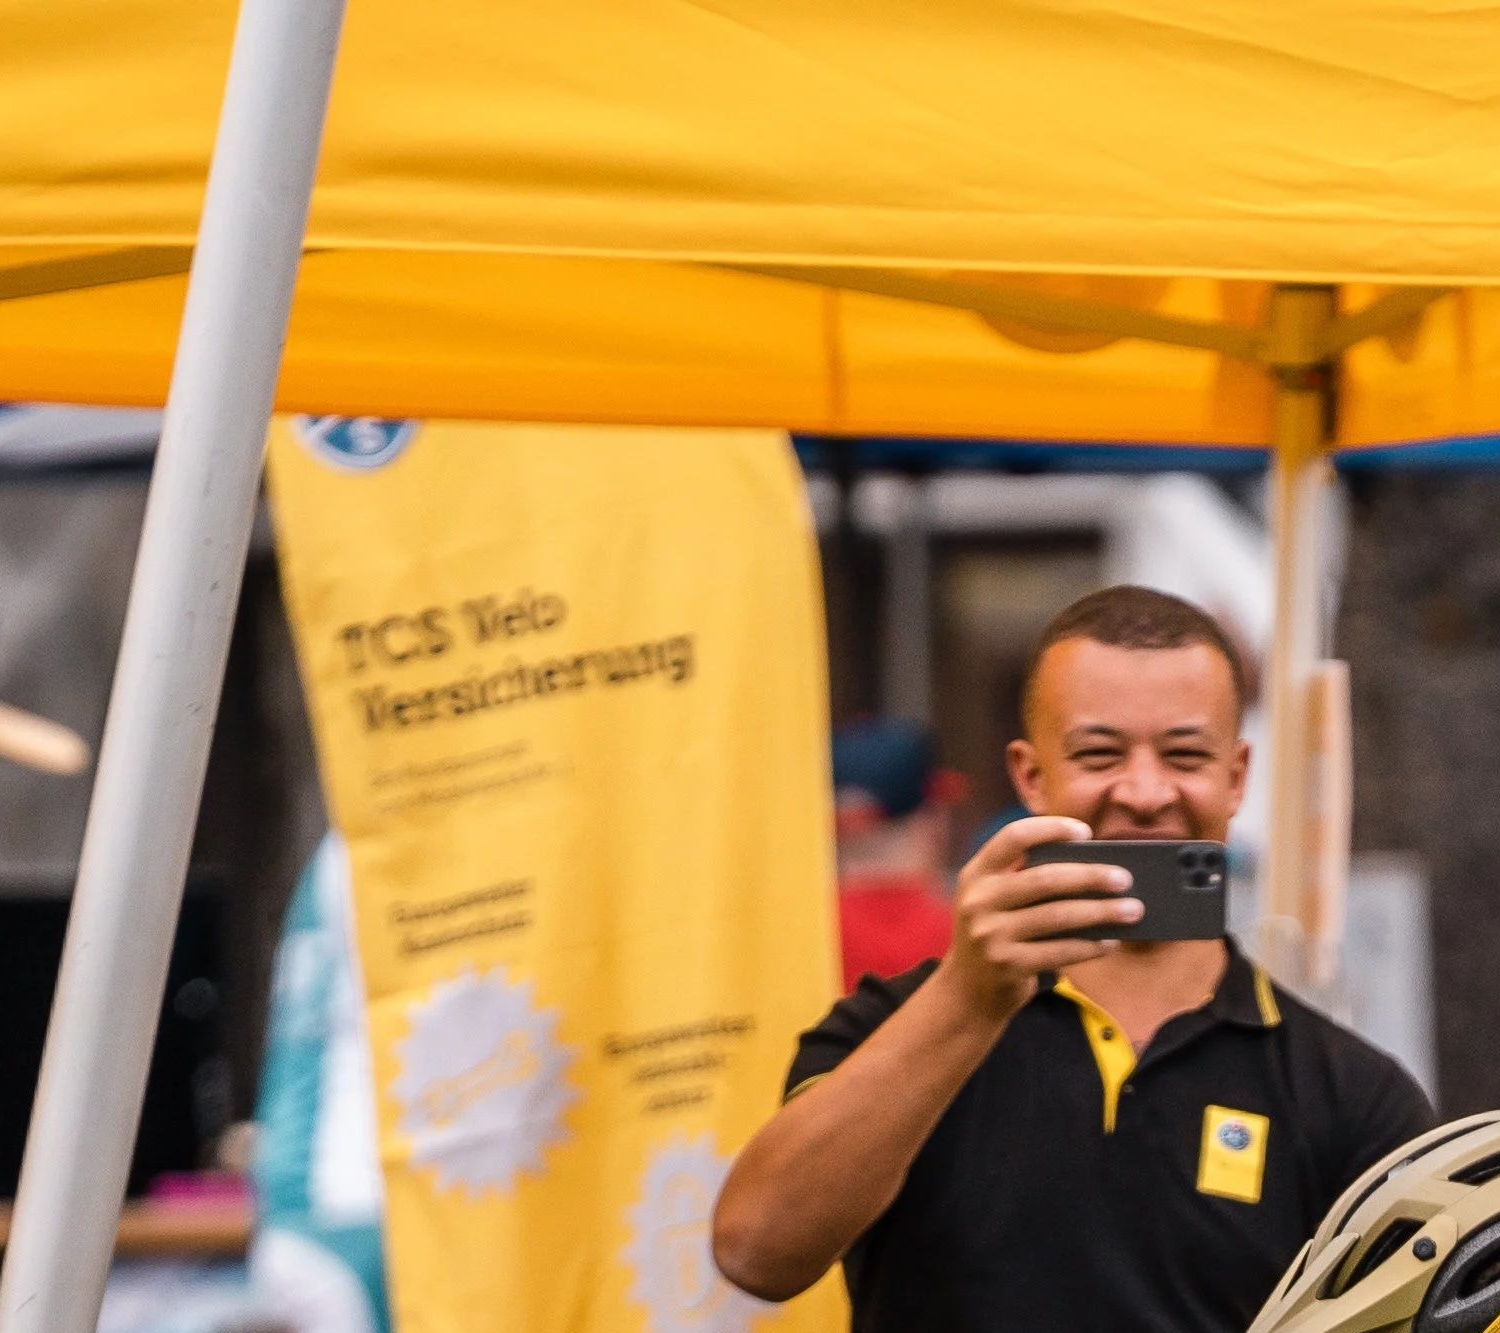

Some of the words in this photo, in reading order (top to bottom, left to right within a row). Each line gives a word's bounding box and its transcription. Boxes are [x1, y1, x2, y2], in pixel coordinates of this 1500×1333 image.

[338, 605, 453, 674] TCS
[461, 587, 568, 643] Velo
[354, 633, 696, 733] Versicherung
